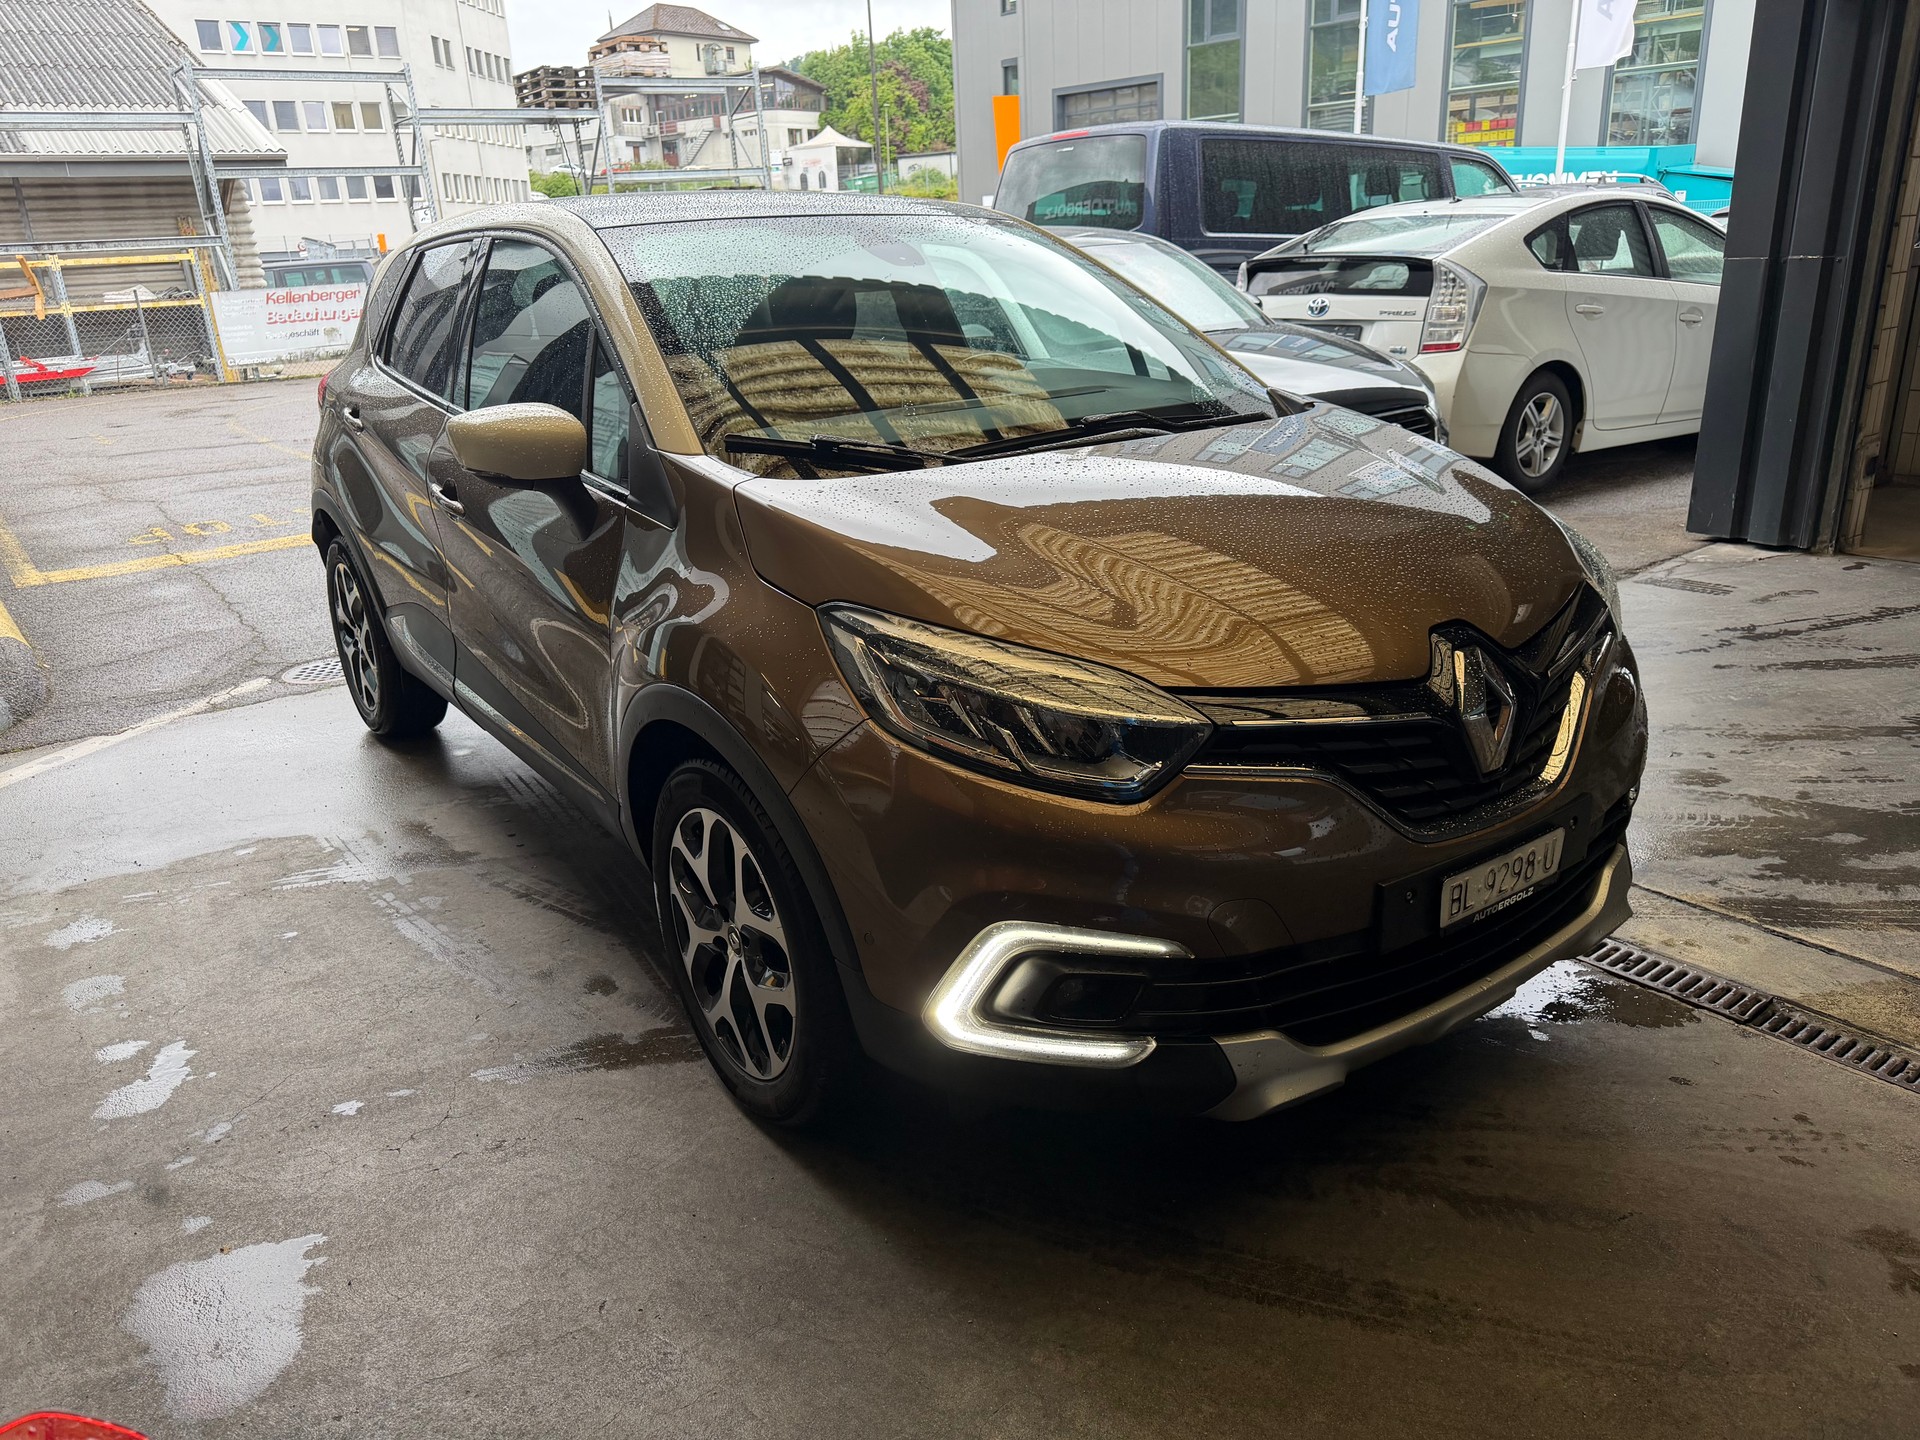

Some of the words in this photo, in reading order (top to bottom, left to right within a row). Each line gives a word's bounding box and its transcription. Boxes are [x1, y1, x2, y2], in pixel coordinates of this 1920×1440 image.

[1387, 0, 1401, 53] AU
[266, 288, 361, 305] Kellenberger
[1449, 878, 1474, 919] BL
[1483, 847, 1537, 904] 9298
[1543, 837, 1558, 873] U
[1474, 887, 1534, 922] AUTOERGOLZ
